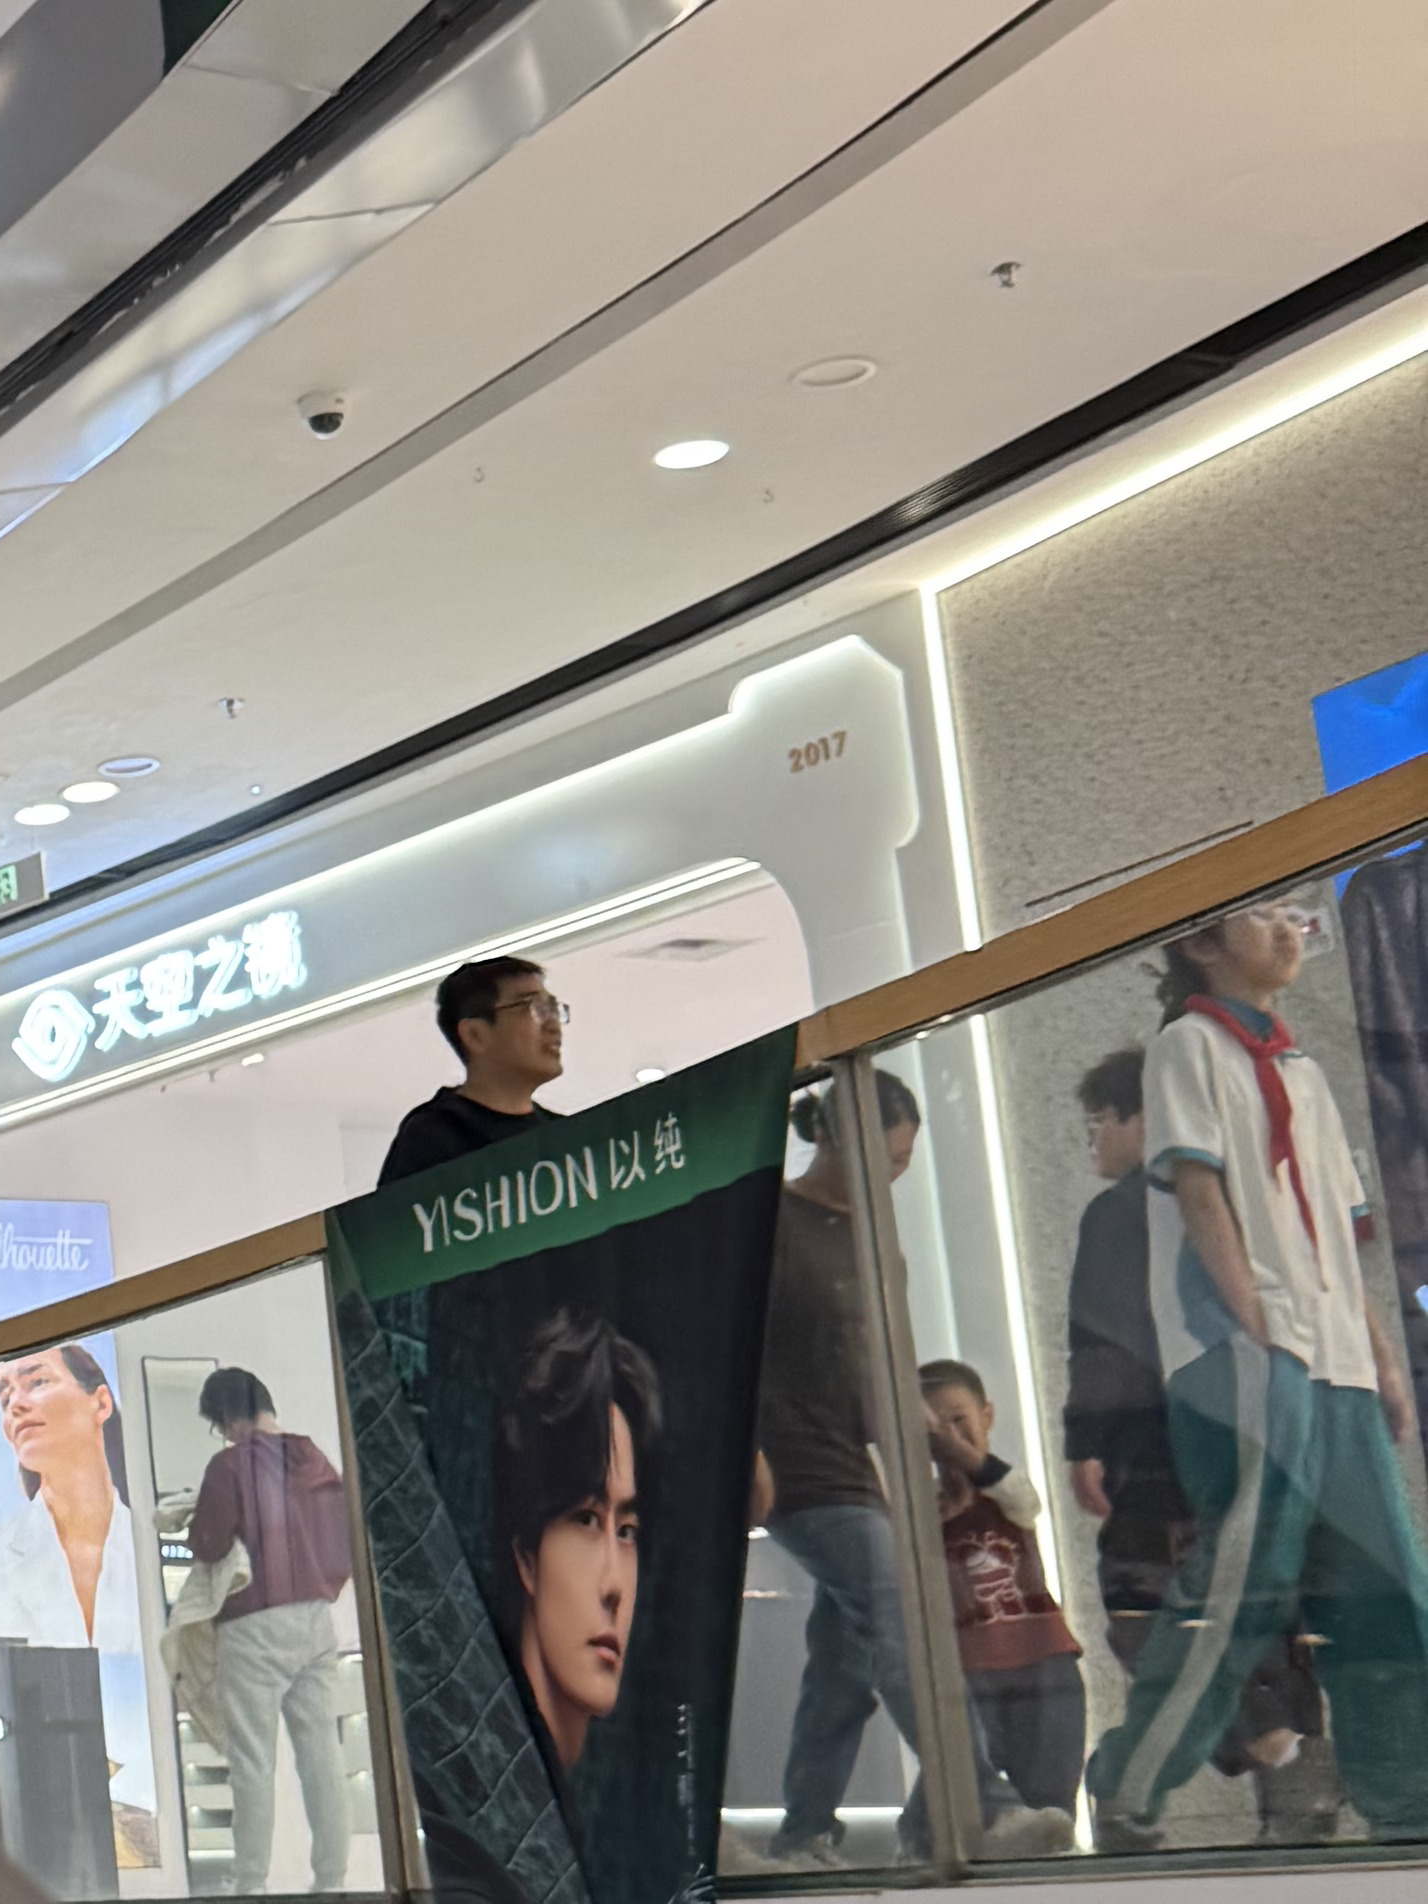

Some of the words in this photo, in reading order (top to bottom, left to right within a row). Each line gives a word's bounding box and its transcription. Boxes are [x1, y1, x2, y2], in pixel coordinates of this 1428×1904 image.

[788, 730, 847, 774] 2017
[413, 1146, 598, 1253] YISHION
[609, 1112, 686, 1191] 以纯
